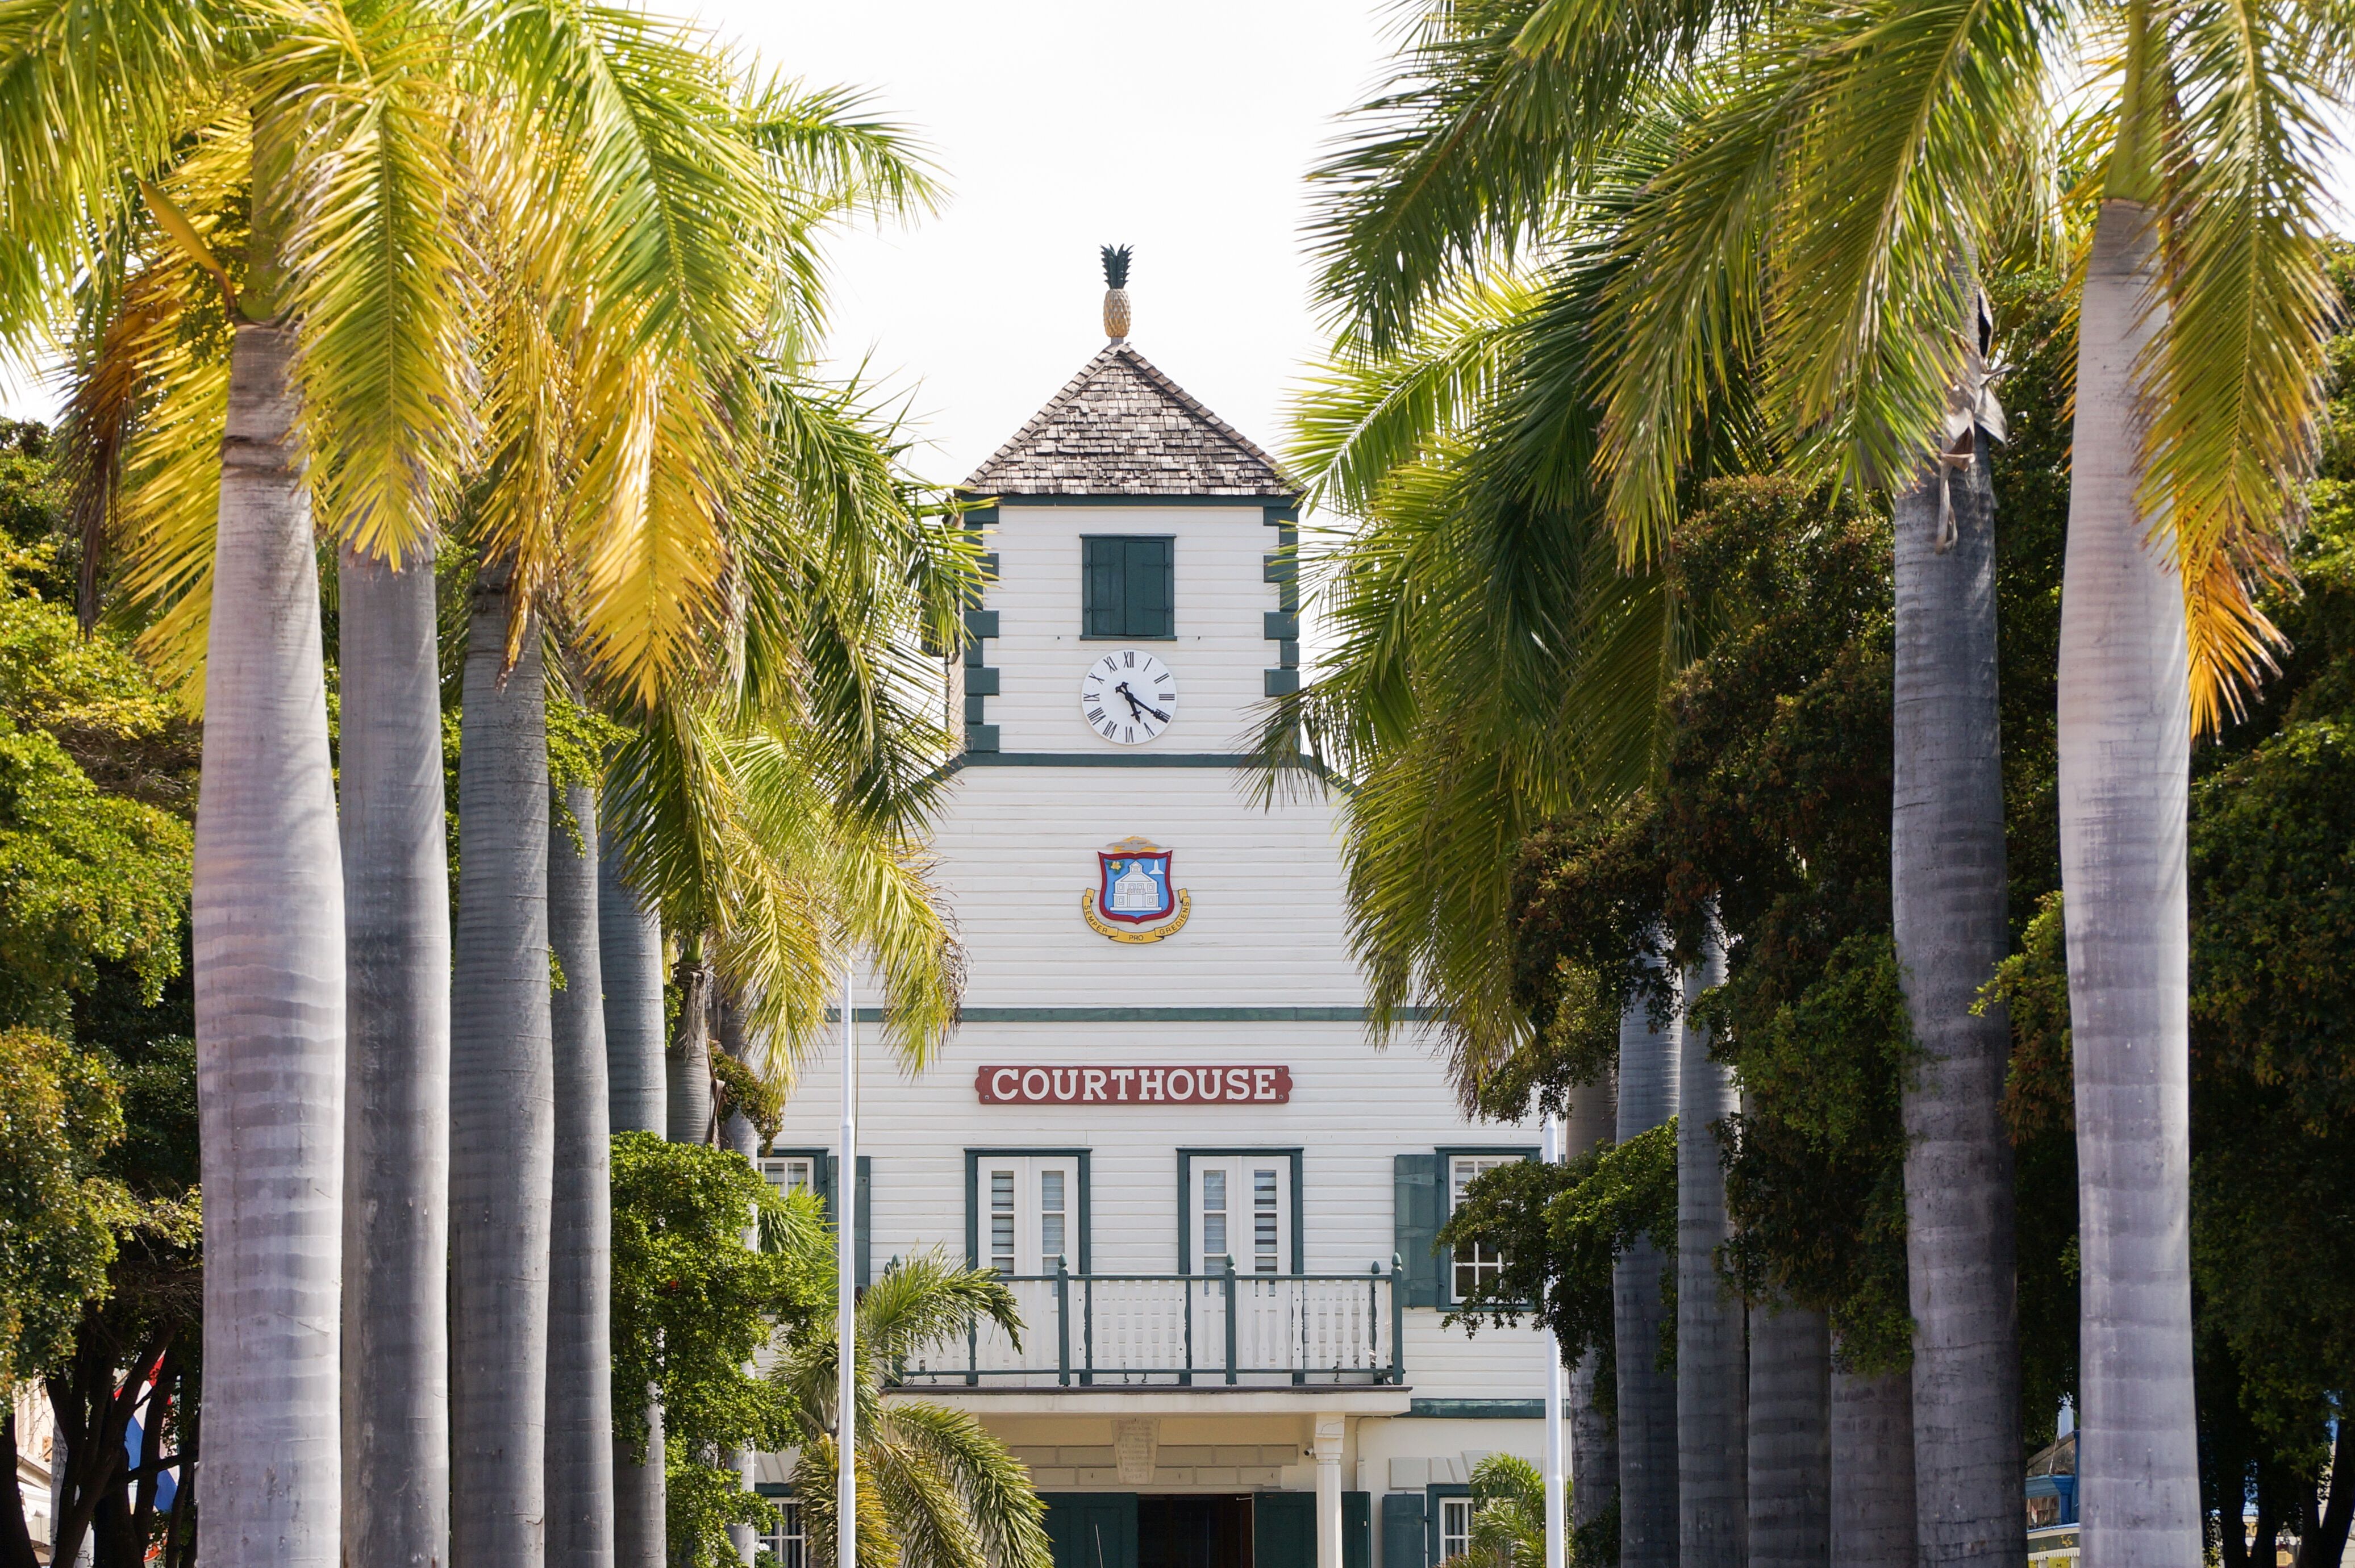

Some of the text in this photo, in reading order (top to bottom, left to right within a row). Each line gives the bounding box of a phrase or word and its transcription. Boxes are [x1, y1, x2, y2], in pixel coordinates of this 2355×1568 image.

[1123, 652, 1134, 668] XII
[1084, 905, 1108, 934] SEMPER
[1159, 902, 1190, 935] GREDIENS
[991, 1069, 1276, 1100] COURTHOUSE
